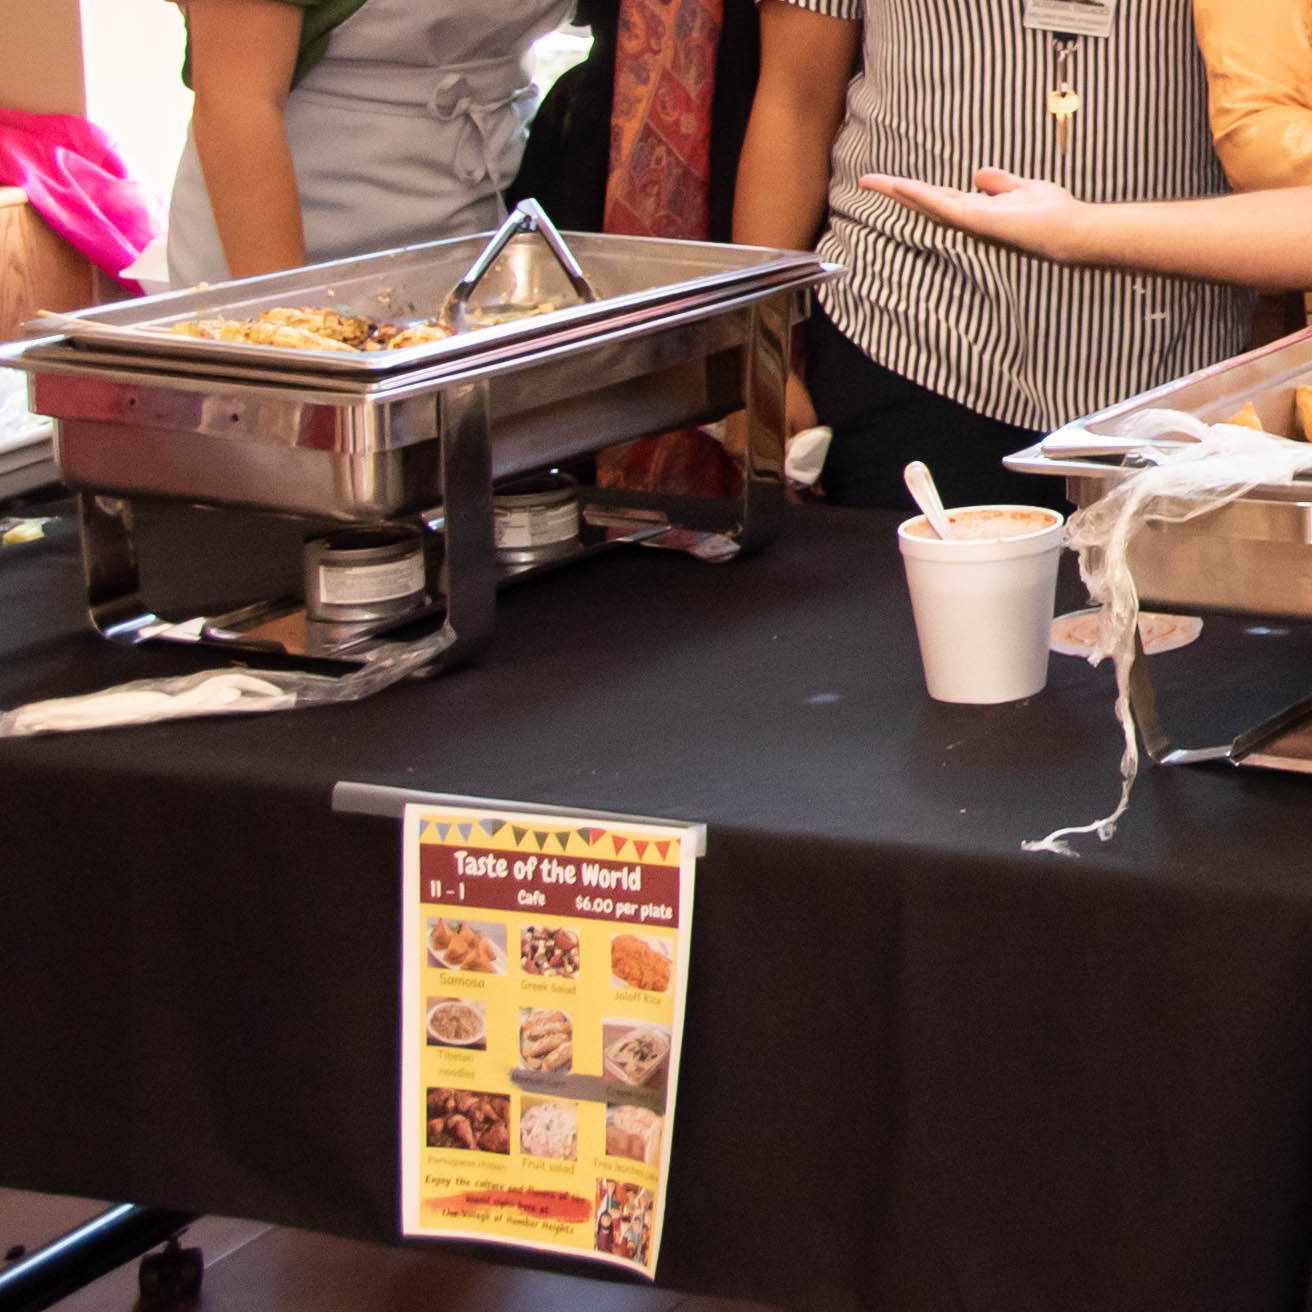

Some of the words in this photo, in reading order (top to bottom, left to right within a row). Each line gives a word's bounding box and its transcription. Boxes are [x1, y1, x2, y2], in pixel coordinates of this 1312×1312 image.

[454, 850, 508, 878] Taste
[513, 856, 538, 880] of
[540, 861, 577, 886] the
[581, 863, 641, 891] World
[517, 889, 546, 906] Cafe
[576, 895, 613, 914] $6.00
[615, 900, 638, 919] per
[640, 902, 673, 922] plate
[440, 973, 485, 990] Samosa
[520, 980, 547, 993] Greek
[425, 1175, 452, 1188] Enjoy
[455, 1177, 470, 1186] the
